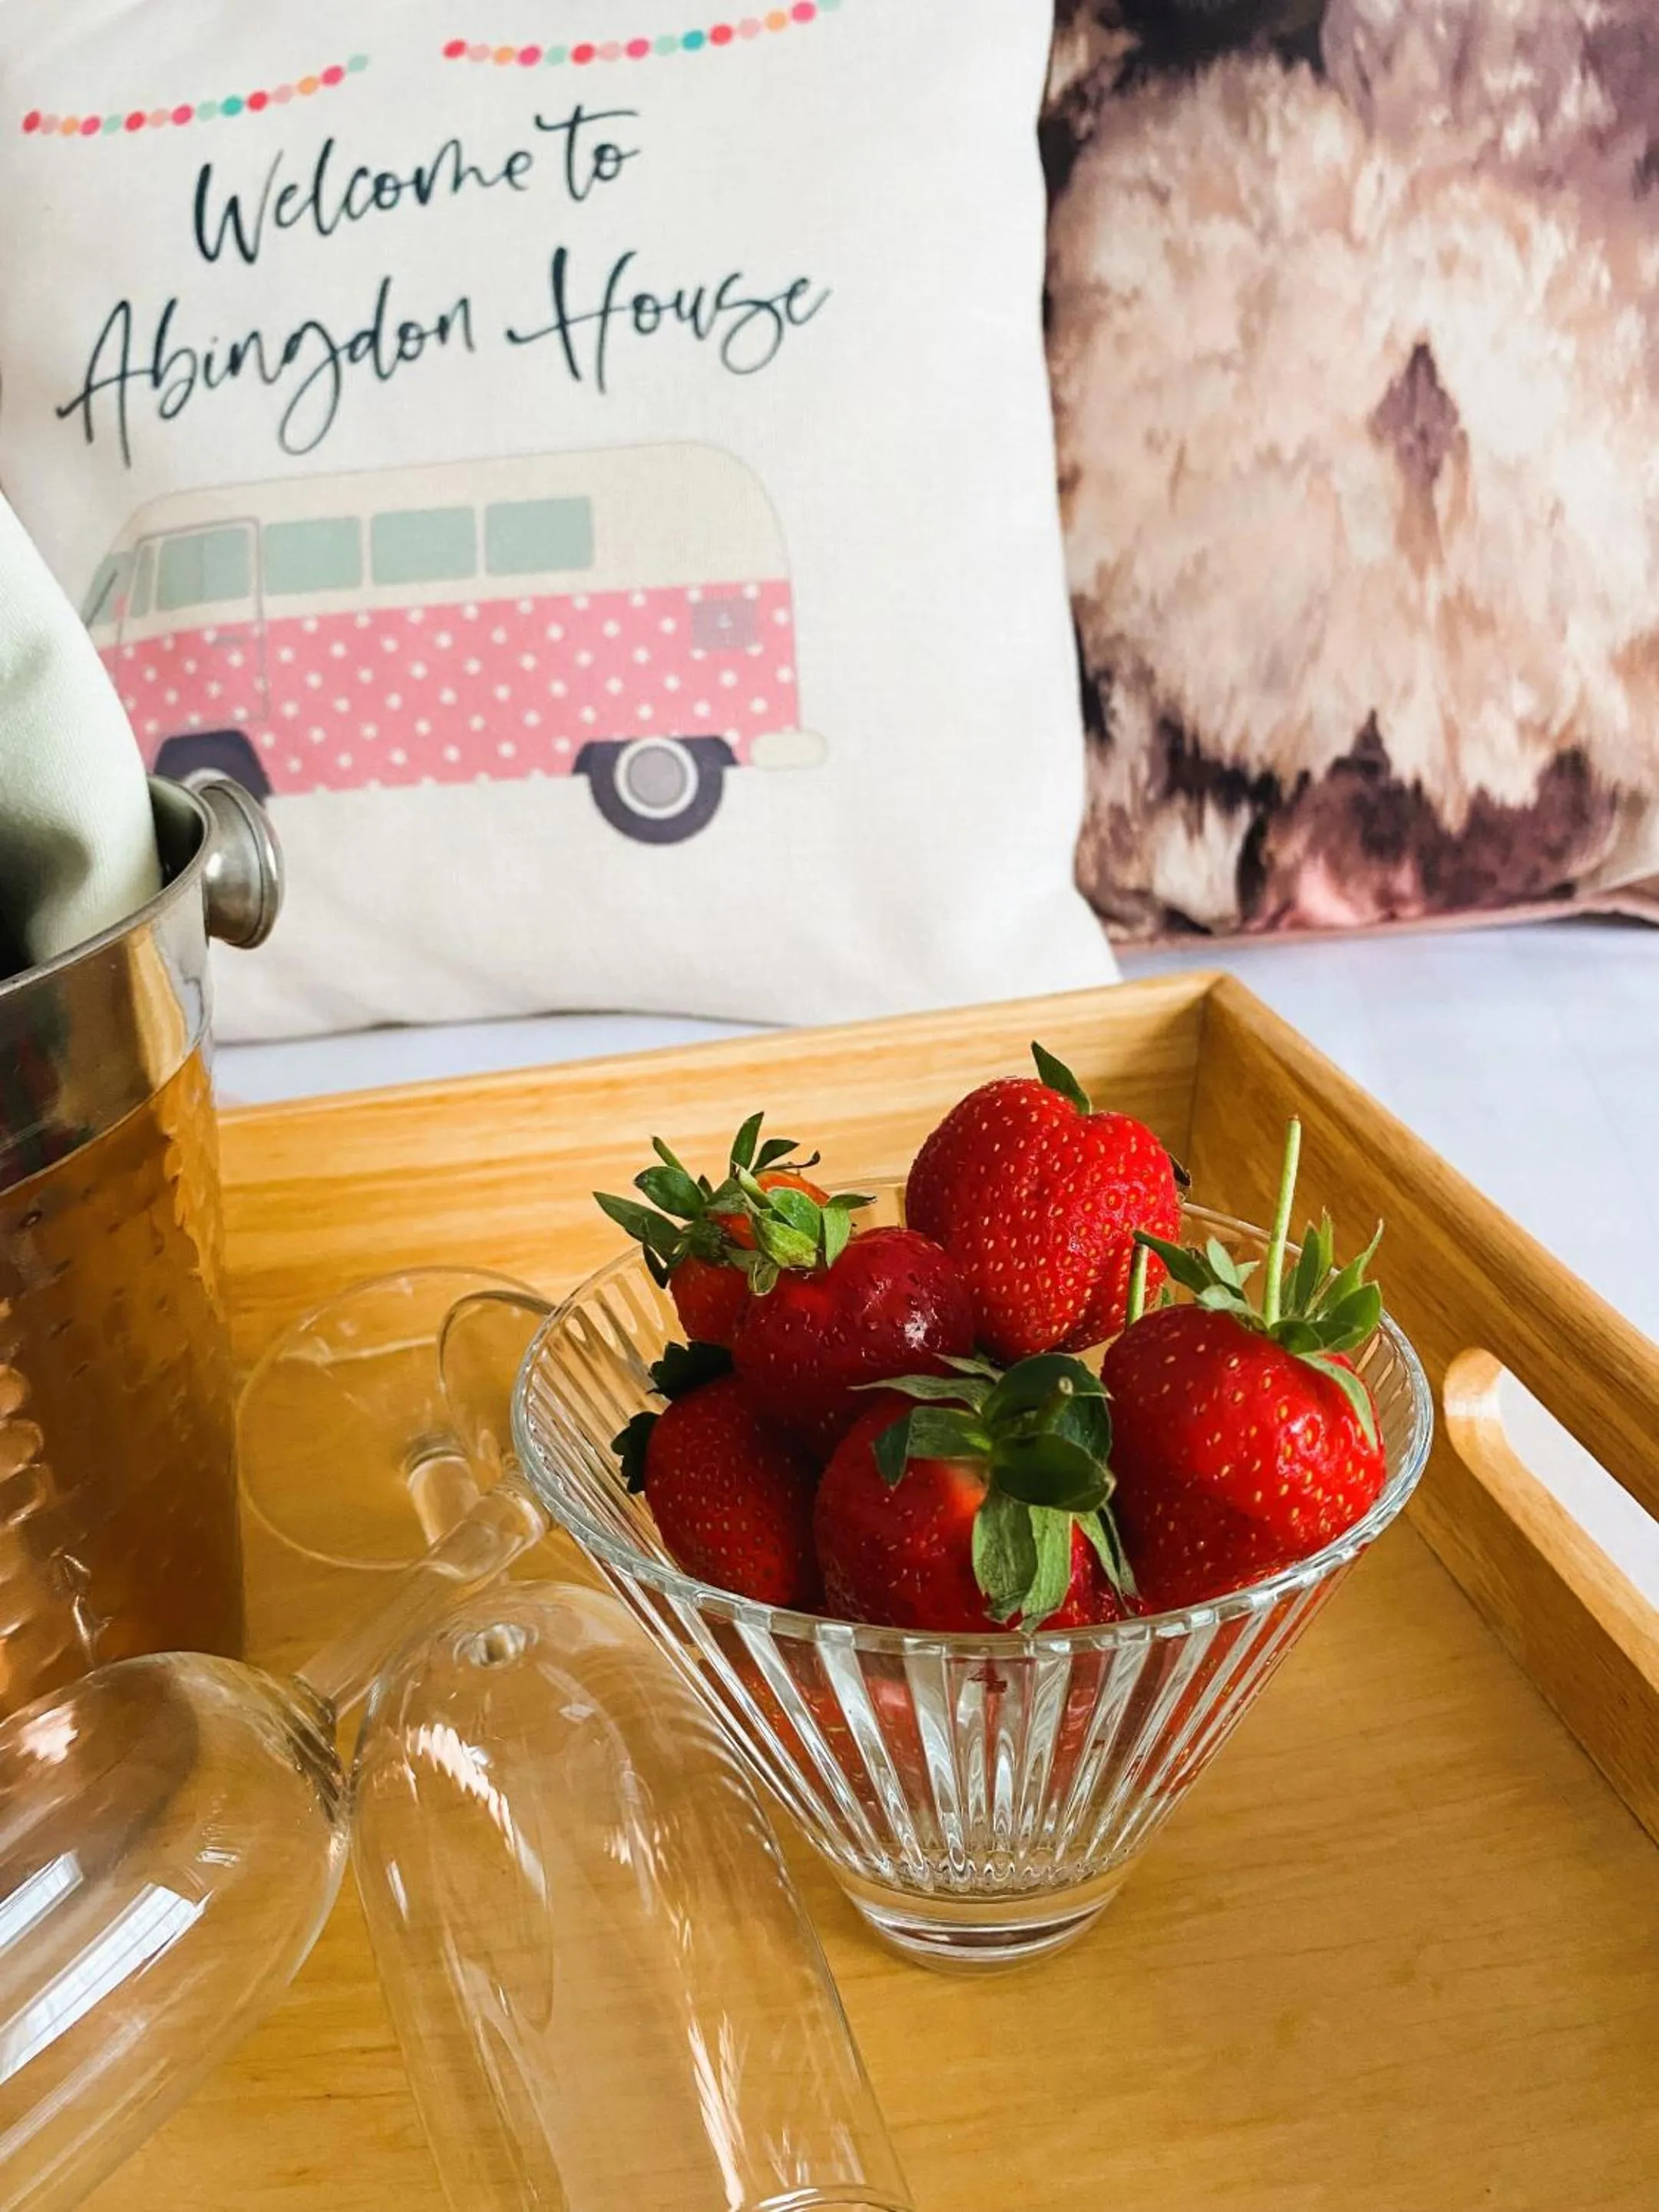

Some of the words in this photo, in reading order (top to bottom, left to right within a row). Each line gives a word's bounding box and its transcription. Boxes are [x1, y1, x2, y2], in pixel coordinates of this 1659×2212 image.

[192, 137, 533, 264] Welcome
[534, 104, 639, 202] to
[55, 276, 475, 468] Abingdon
[505, 246, 833, 395] House
